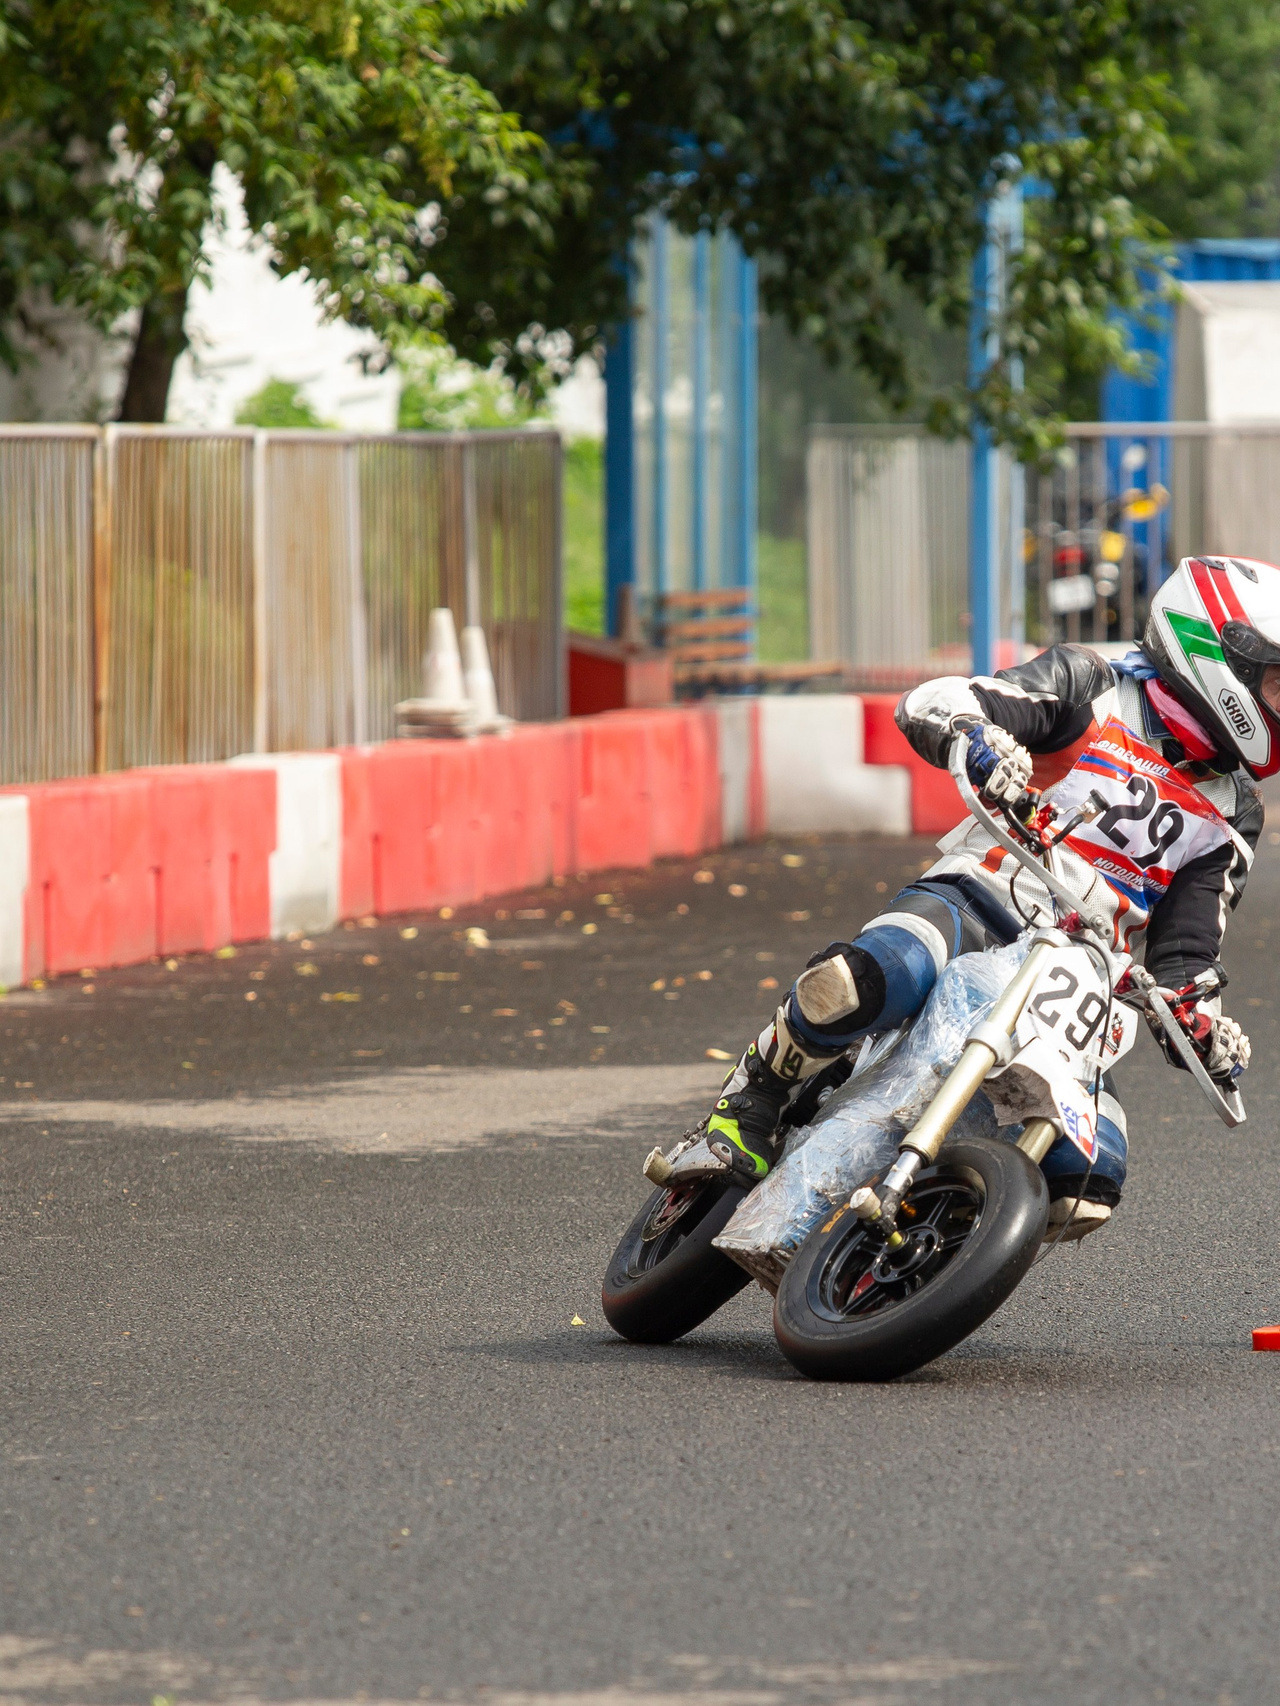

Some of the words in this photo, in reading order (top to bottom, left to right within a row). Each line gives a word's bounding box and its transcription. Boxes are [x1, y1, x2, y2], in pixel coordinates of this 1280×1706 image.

[1221, 695, 1253, 736] SHOEI
[1096, 775, 1185, 870] 29
[1028, 966, 1108, 1051] 29
